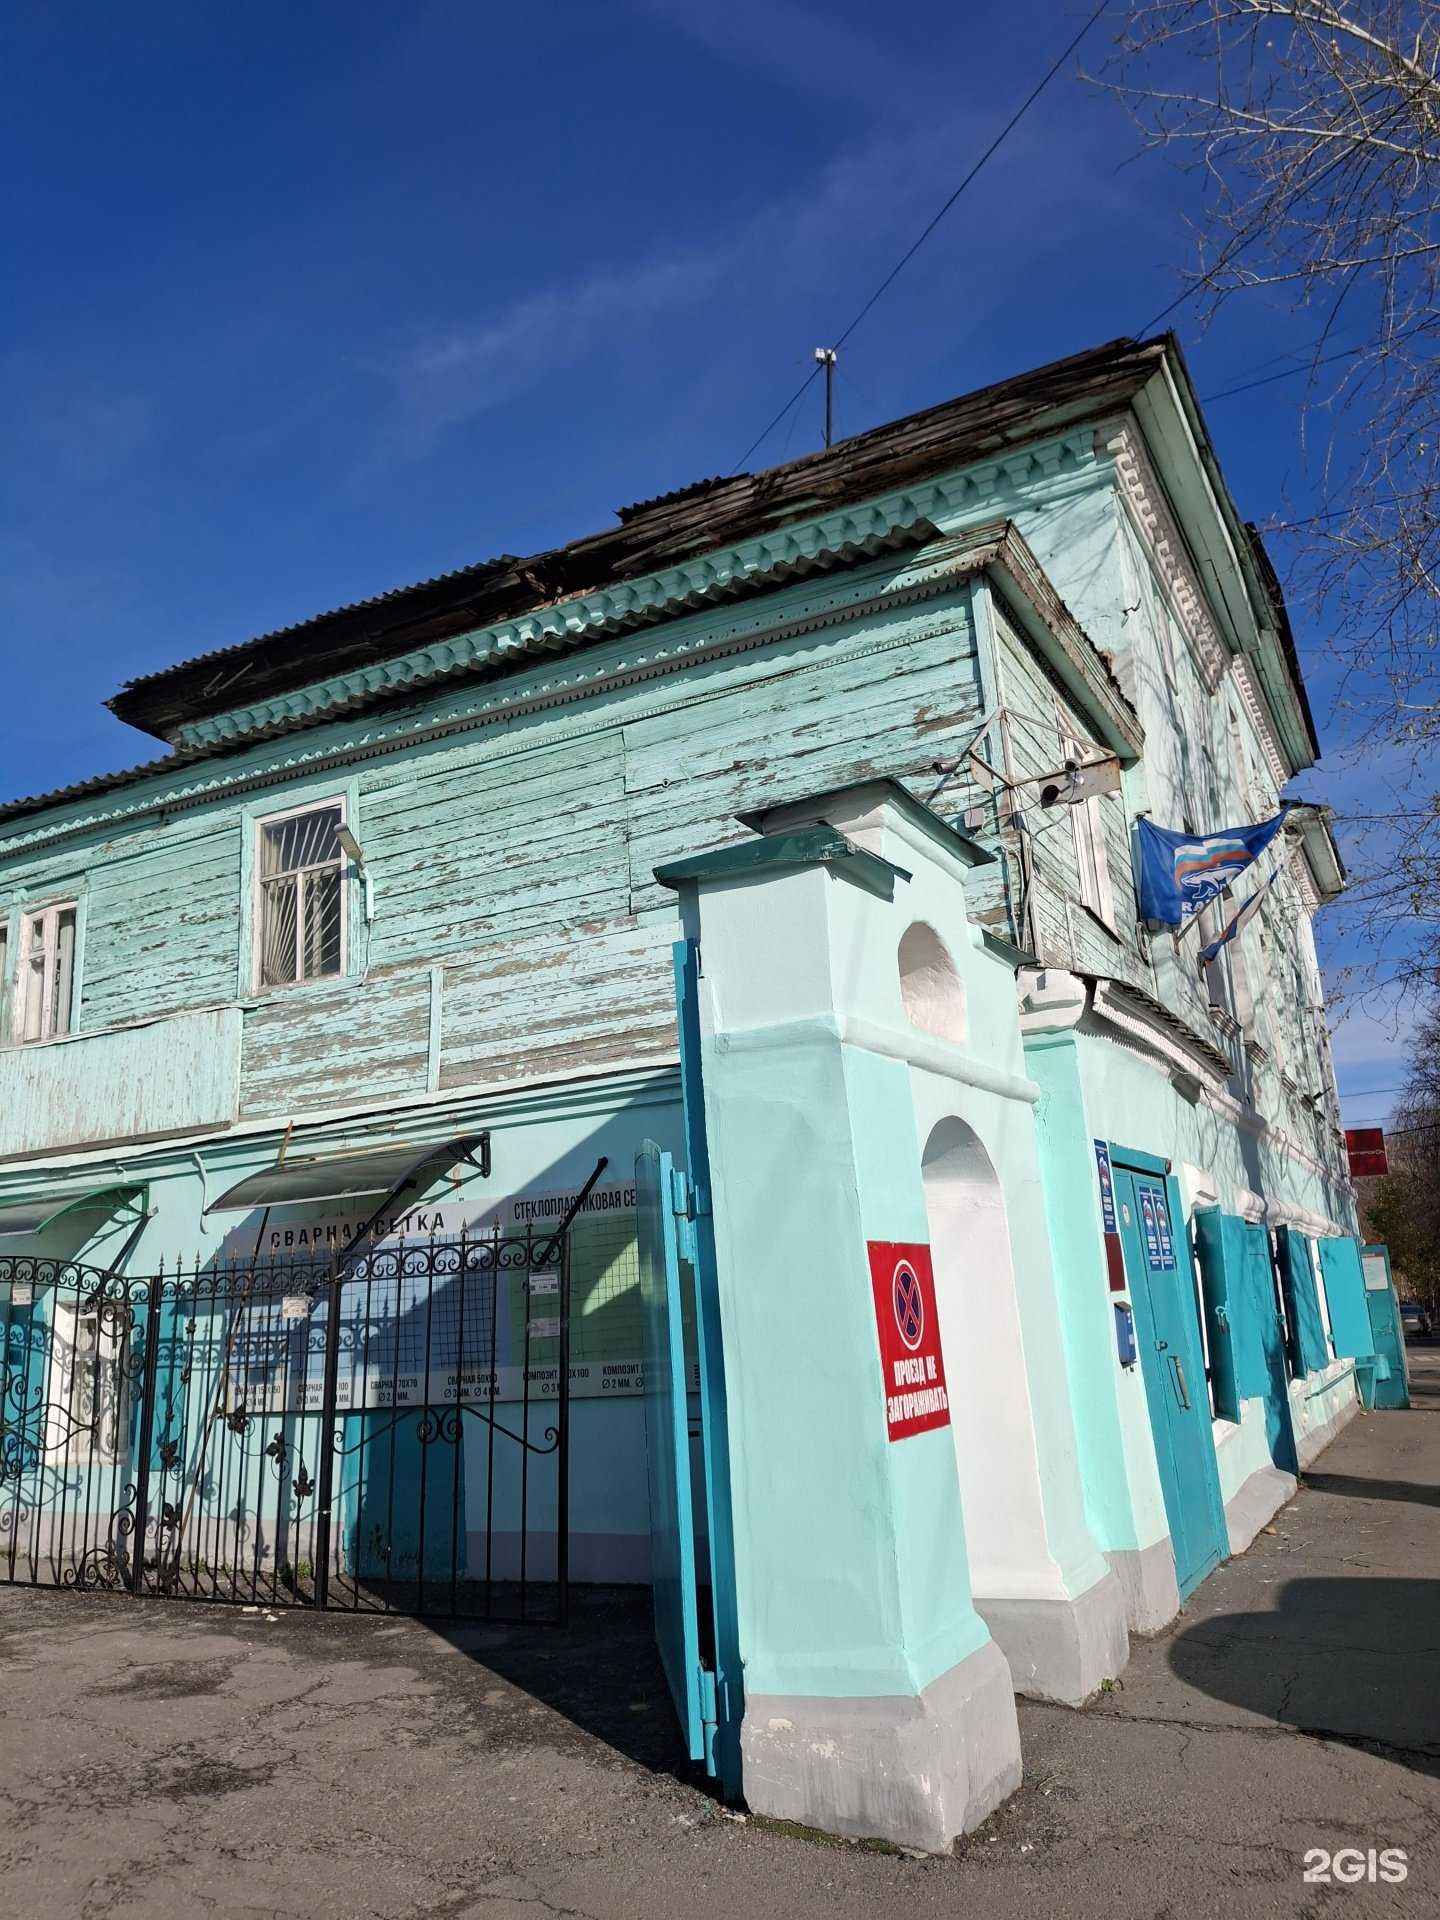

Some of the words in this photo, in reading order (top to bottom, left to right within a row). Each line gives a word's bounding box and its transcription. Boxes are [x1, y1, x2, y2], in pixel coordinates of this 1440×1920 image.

[514, 1190, 621, 1220] СТЕКЛОПЛАСИКОВАЯ
[374, 1212, 445, 1236] СЕТКА
[523, 1368, 558, 1381] ОМПОЗИТ
[602, 1364, 640, 1377] КОМПОЗИТ
[893, 1356, 927, 1387] ПРОЕЗД
[925, 1355, 938, 1380] НЕ
[887, 1385, 948, 1424] ЗАГОРАЖИВАТЬ
